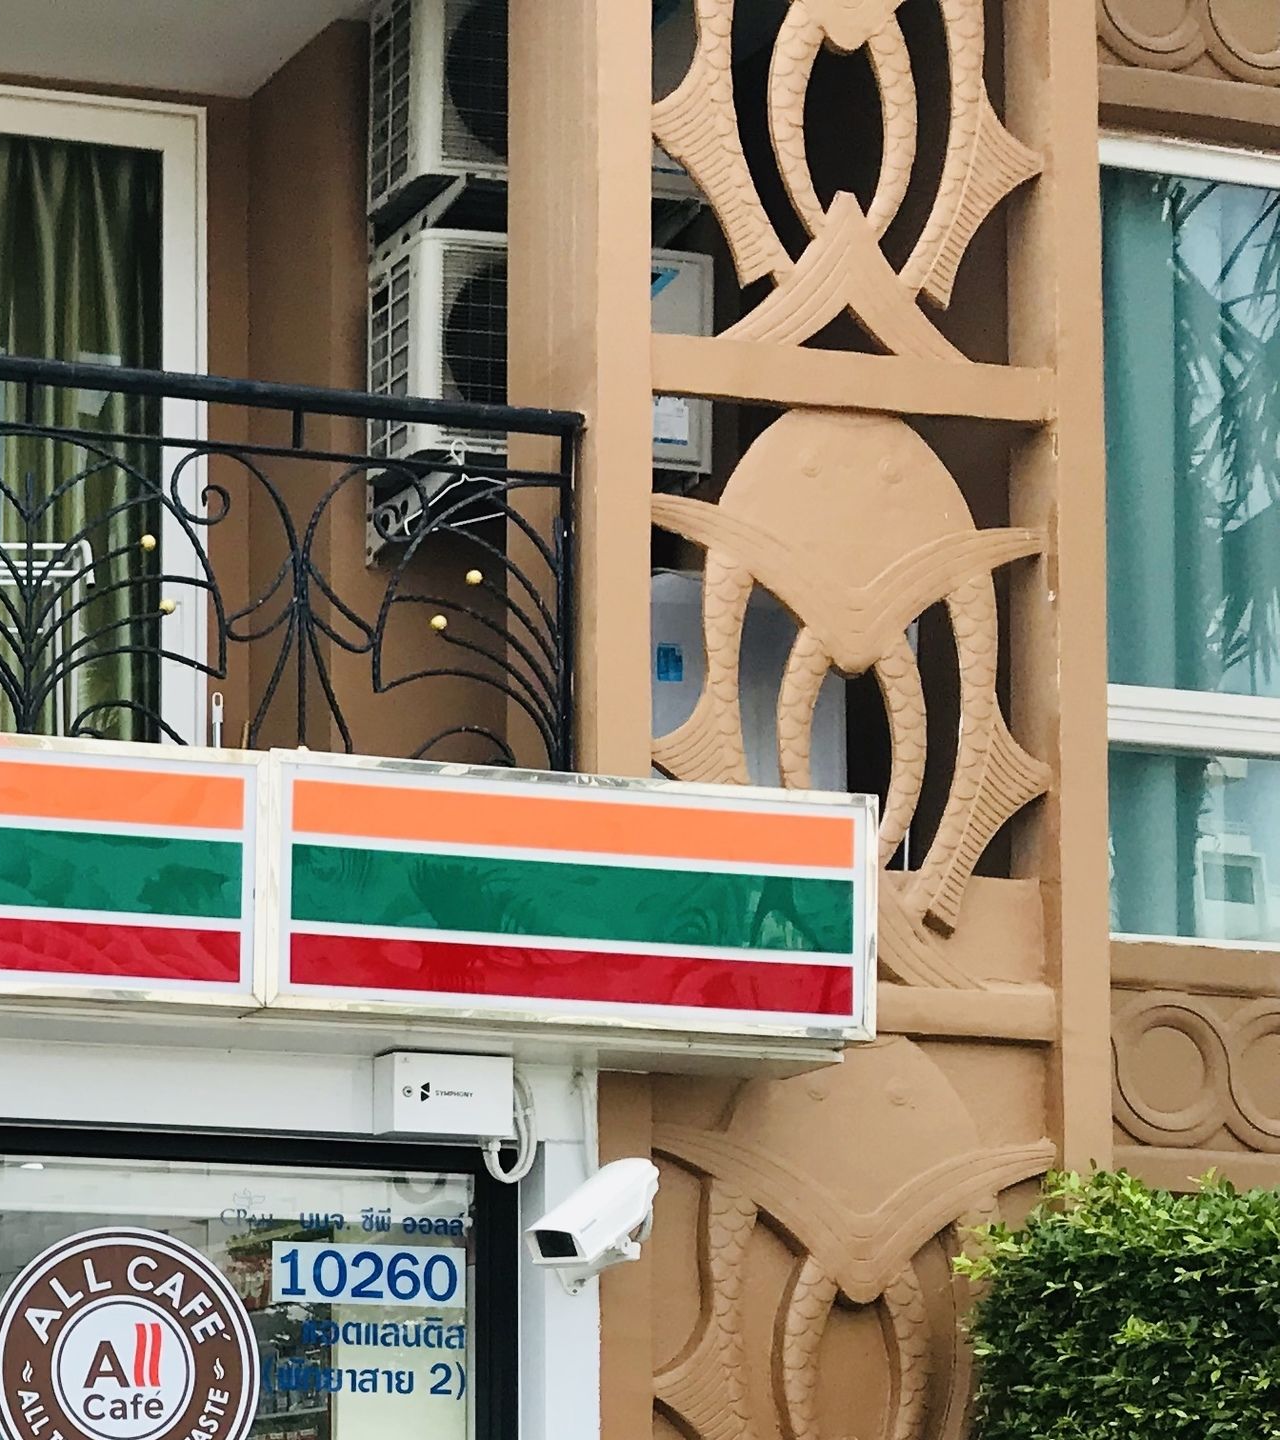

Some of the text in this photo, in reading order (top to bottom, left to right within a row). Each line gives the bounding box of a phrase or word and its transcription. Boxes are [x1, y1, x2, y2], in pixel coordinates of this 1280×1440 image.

[24, 1255, 232, 1345] ALL CAFÉ
[280, 1248, 458, 1302] 10260
[83, 1322, 163, 1389] All
[82, 1390, 164, 1421] Café
[429, 1361, 467, 1401] 2)
[17, 1390, 51, 1437] ALL
